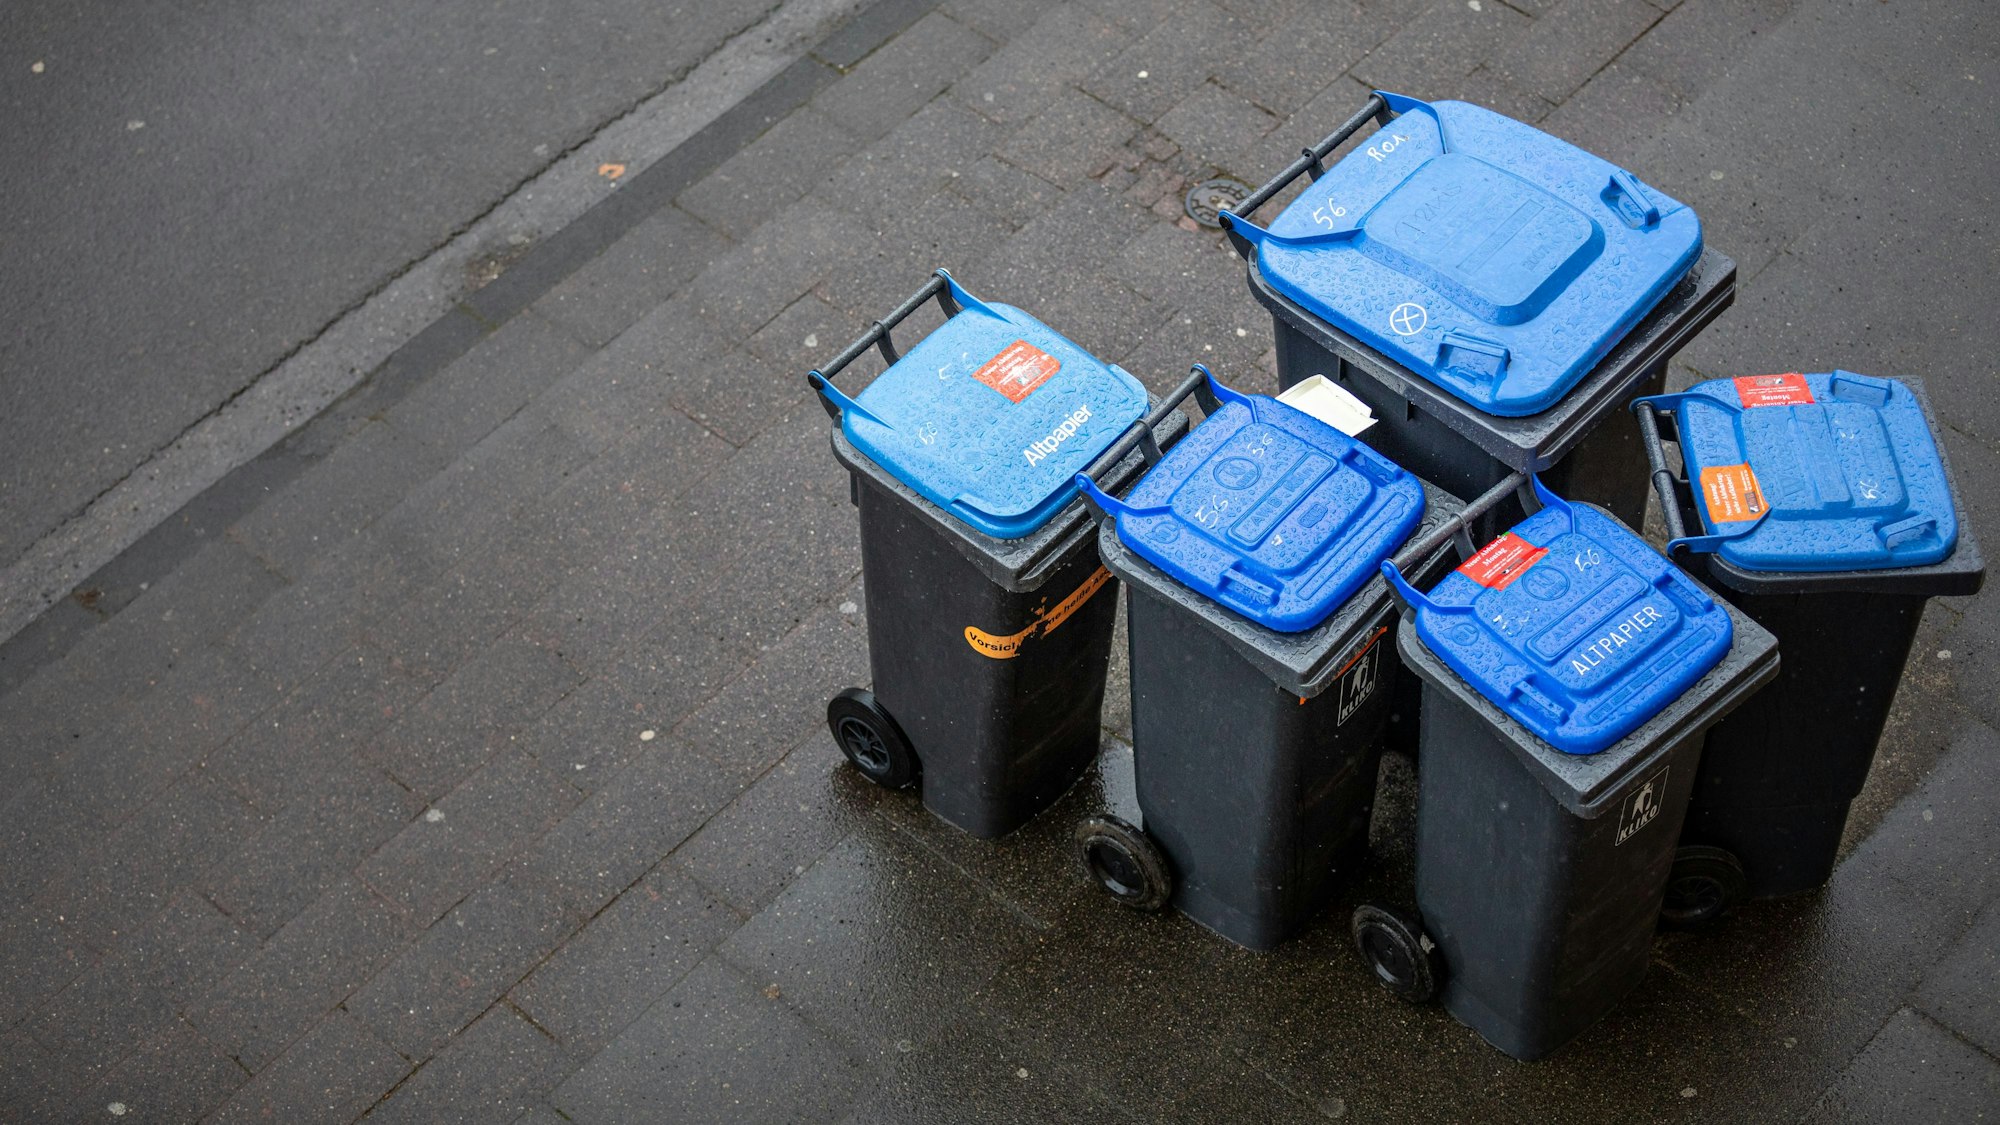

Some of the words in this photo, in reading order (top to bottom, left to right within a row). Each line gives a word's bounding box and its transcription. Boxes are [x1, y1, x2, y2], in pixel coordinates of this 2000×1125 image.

[1312, 197, 1346, 230] 56
[1023, 404, 1093, 467] Altpapier
[1482, 547, 1508, 566] Montag
[1571, 606, 1663, 675] ALTPAPIER
[1341, 680, 1373, 720] KLIKO
[1619, 804, 1657, 841] KLIKO
